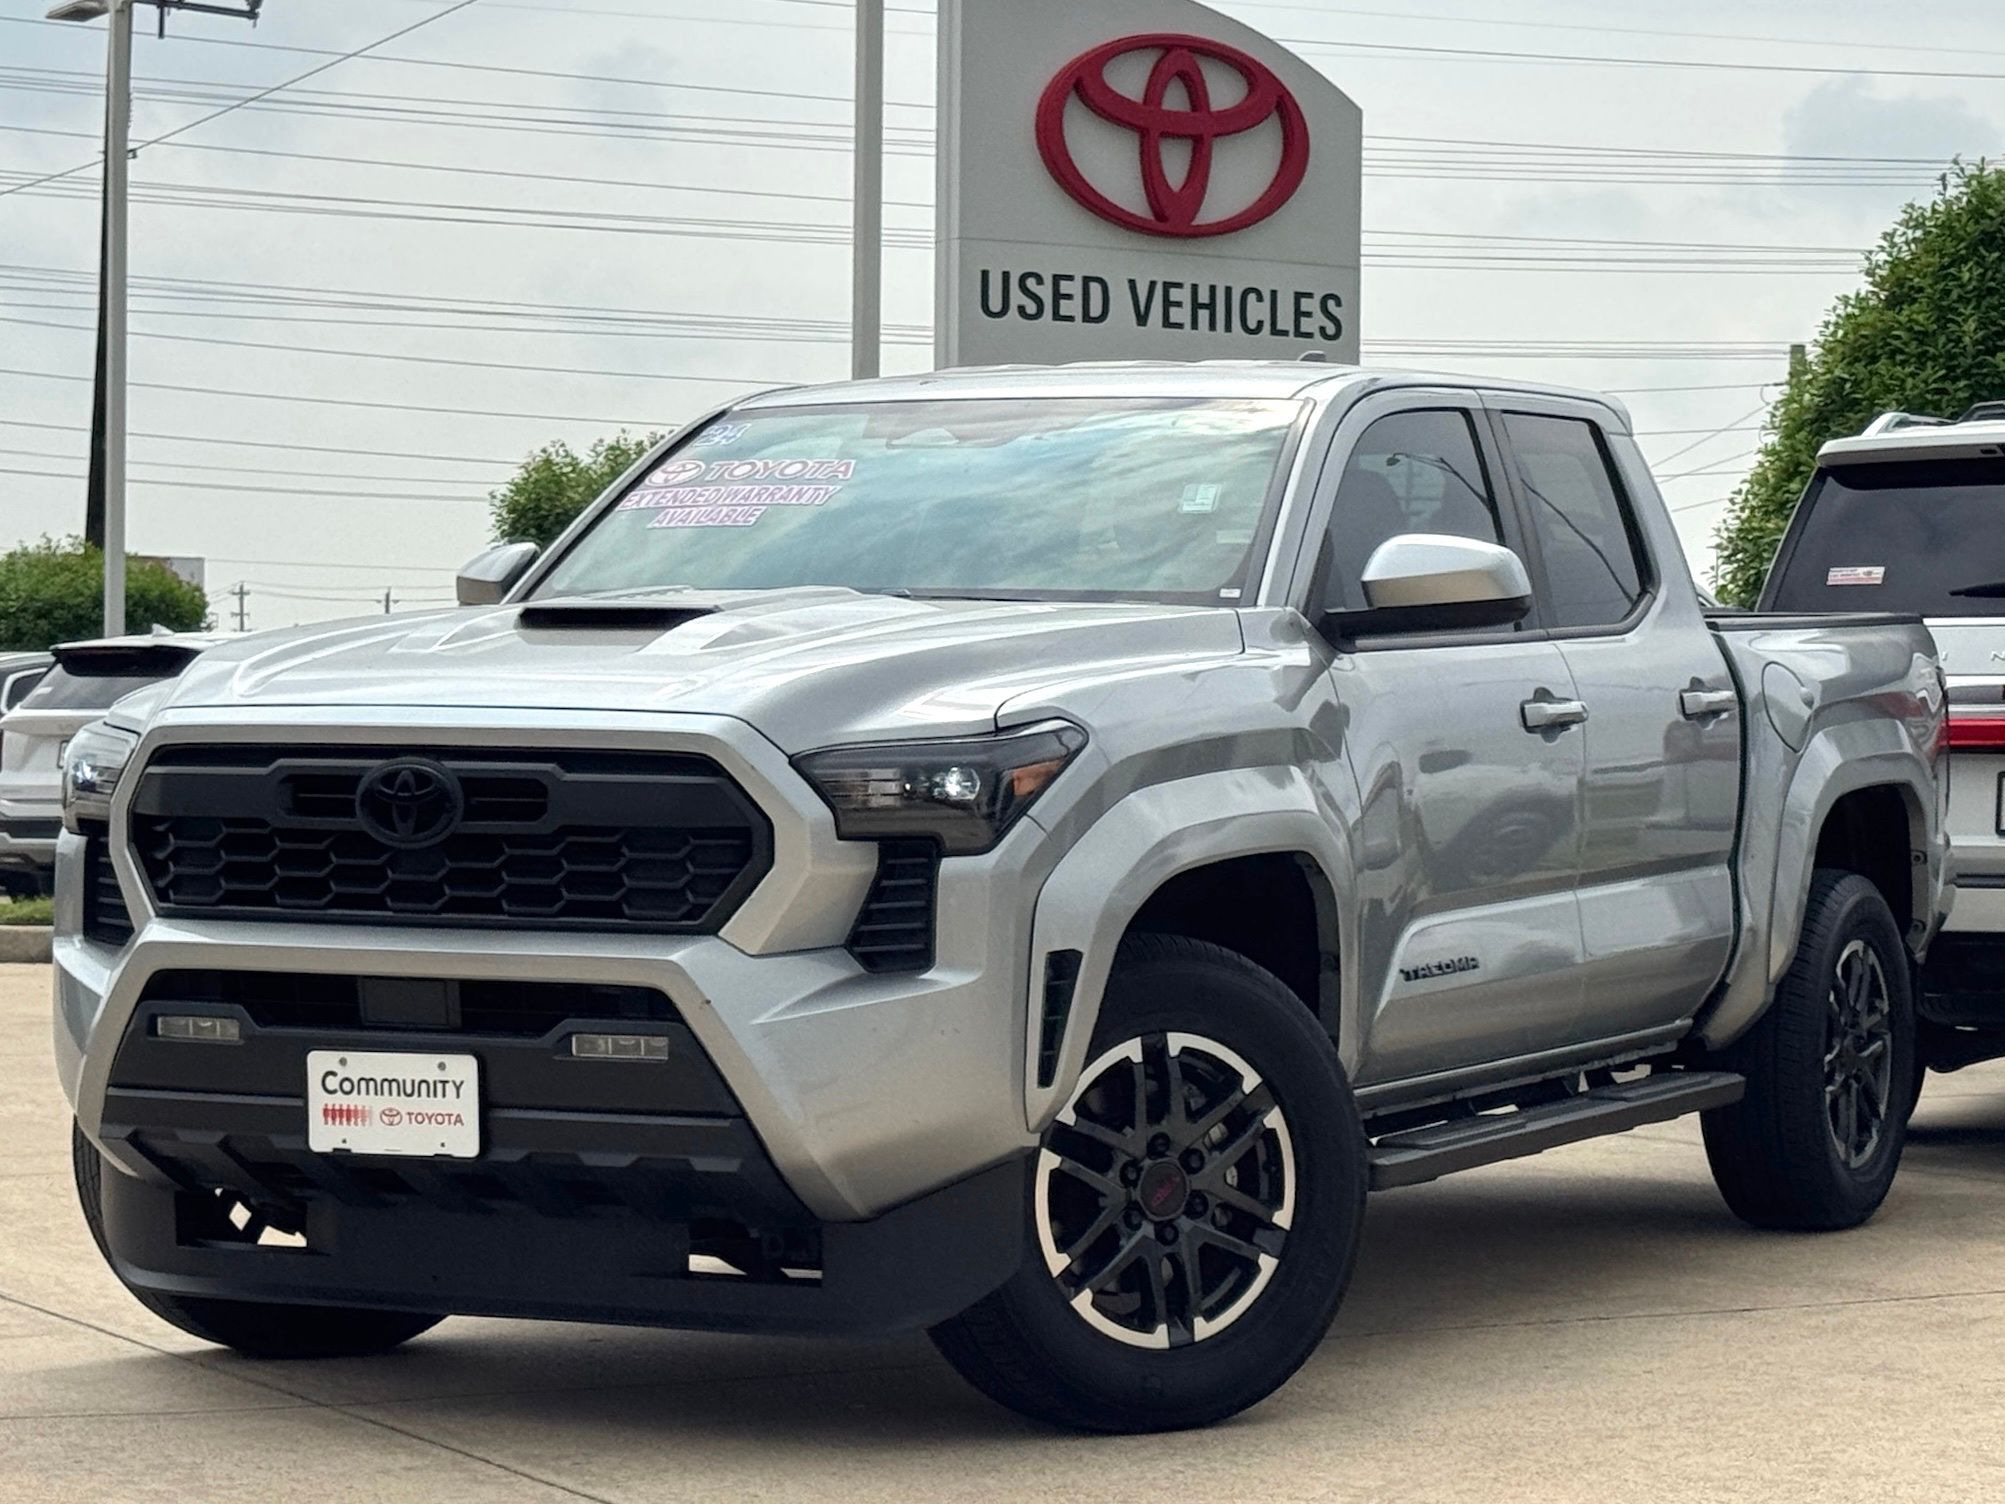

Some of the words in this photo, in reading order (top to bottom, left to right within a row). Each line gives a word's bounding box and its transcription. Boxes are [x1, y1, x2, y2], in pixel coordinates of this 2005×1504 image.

[980, 269, 1111, 324] USED
[1127, 277, 1344, 342] VEHICLES
[705, 459, 856, 481] TOYOTA
[618, 487, 722, 510] EXTENDED
[723, 485, 842, 506] WARRANTY
[648, 506, 768, 528] AVAILABLE
[407, 1111, 465, 1126] TOYOTA
